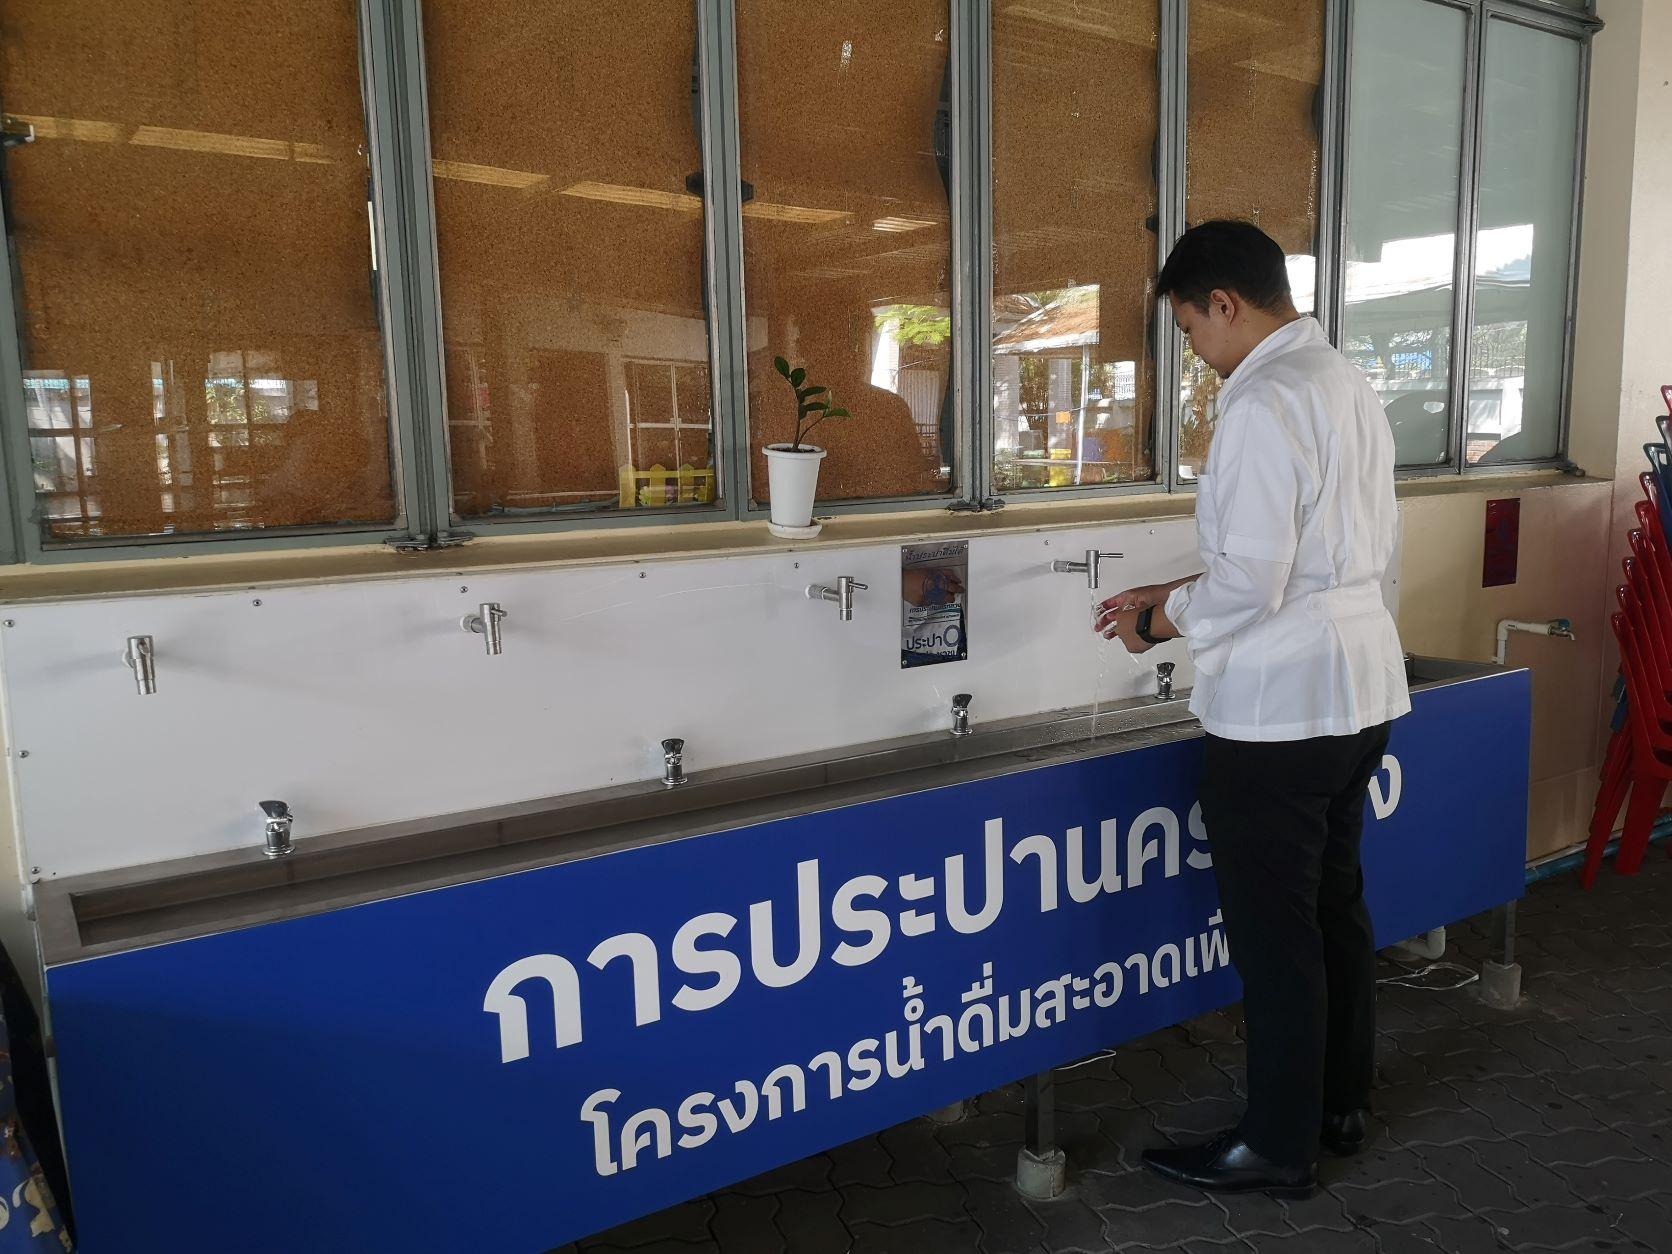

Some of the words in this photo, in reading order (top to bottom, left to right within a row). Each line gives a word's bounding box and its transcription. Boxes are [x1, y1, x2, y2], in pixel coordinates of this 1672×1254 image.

[484, 754, 1401, 1064] การประปานคง
[580, 907, 1230, 1177] โครงการน้ำดื่มสะอาดเพ
